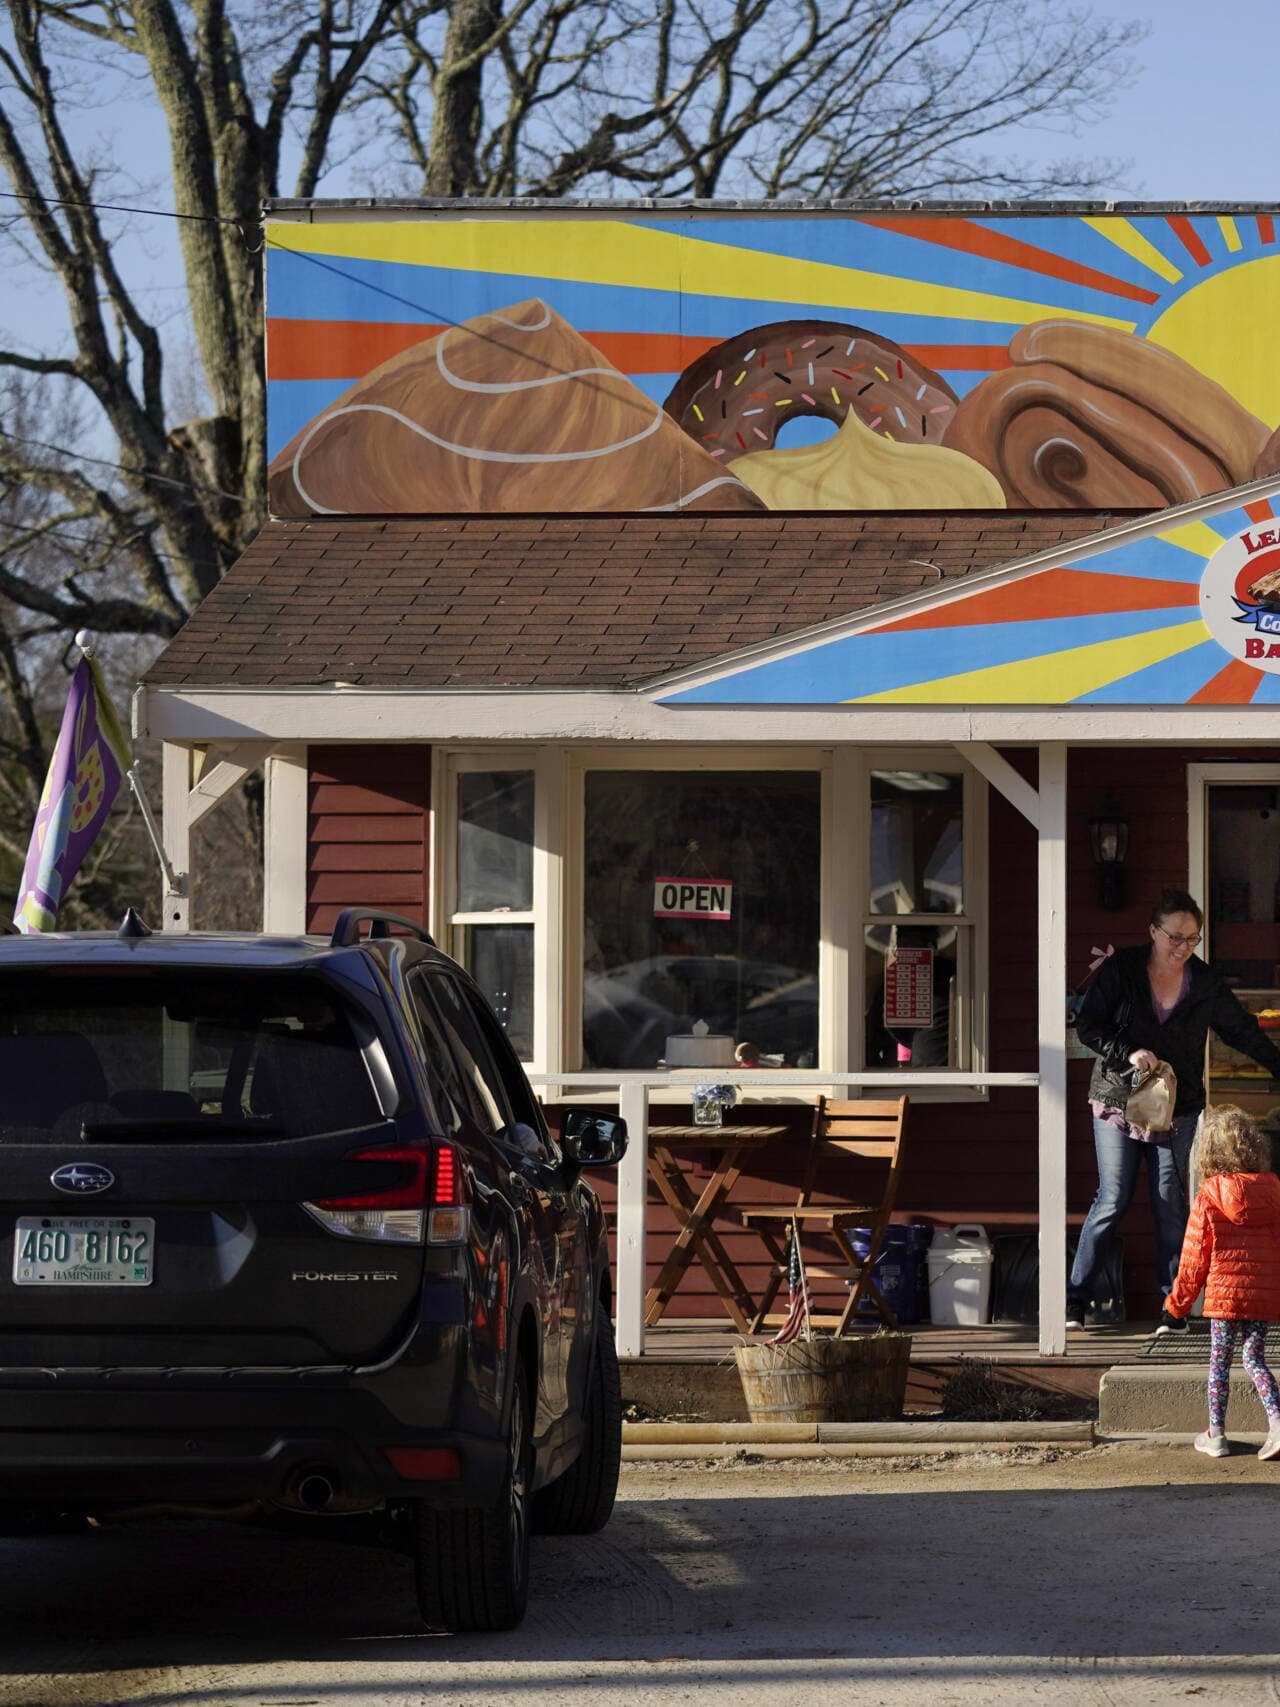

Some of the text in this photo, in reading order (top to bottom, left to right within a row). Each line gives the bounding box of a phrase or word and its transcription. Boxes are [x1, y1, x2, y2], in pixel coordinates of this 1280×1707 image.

[662, 884, 726, 911] OPEN
[21, 1231, 148, 1264] 460 8162
[53, 1271, 113, 1281] HAMPSHIRE
[291, 1270, 400, 1281] FORESTER
